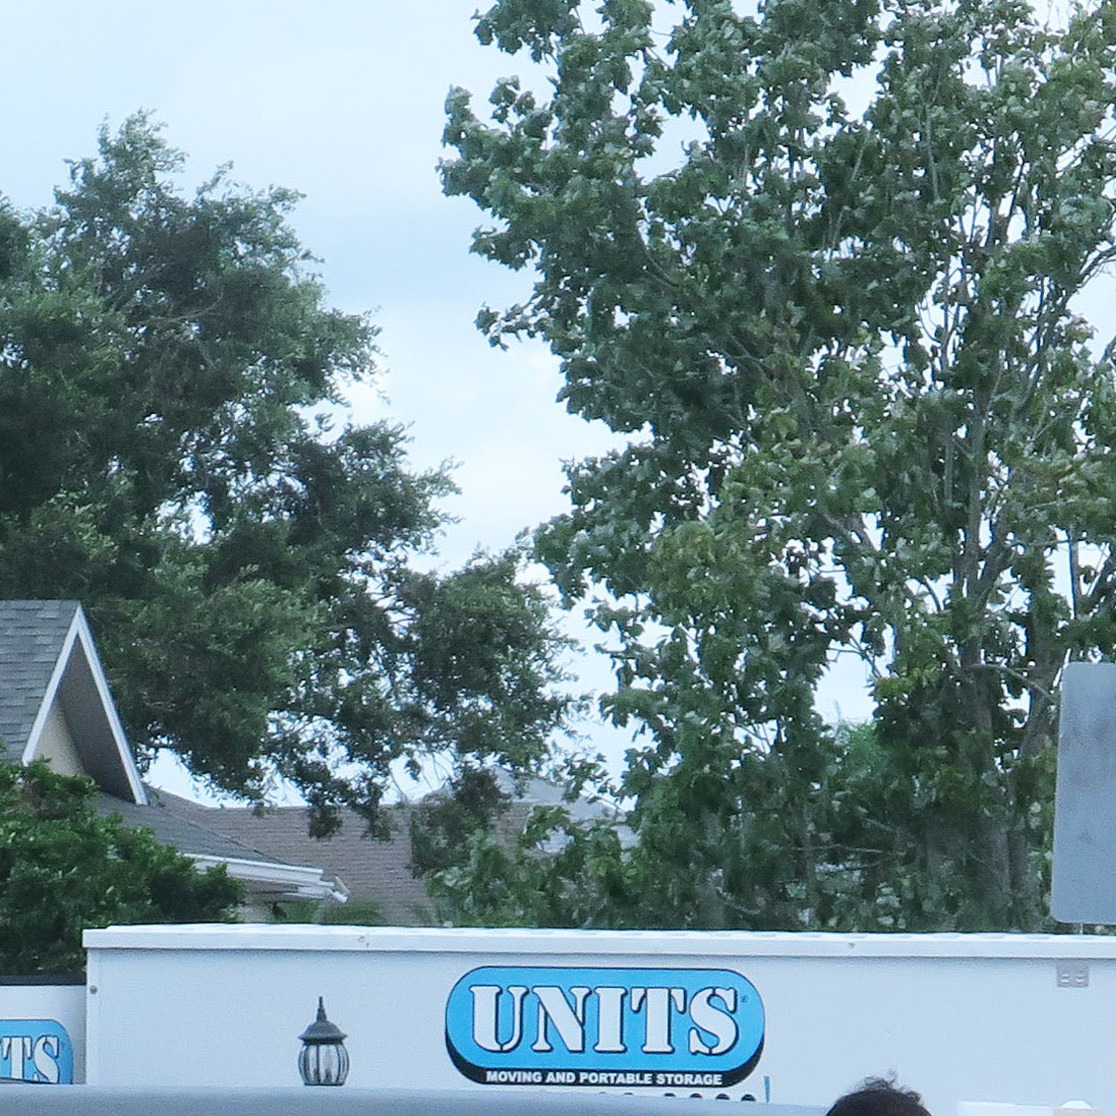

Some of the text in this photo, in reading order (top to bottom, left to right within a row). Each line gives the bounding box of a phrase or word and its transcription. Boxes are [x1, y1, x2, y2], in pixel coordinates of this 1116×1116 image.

[468, 984, 738, 1056] UNITS
[486, 1070, 723, 1085] MOVING AND PORTABLE STORAGE
